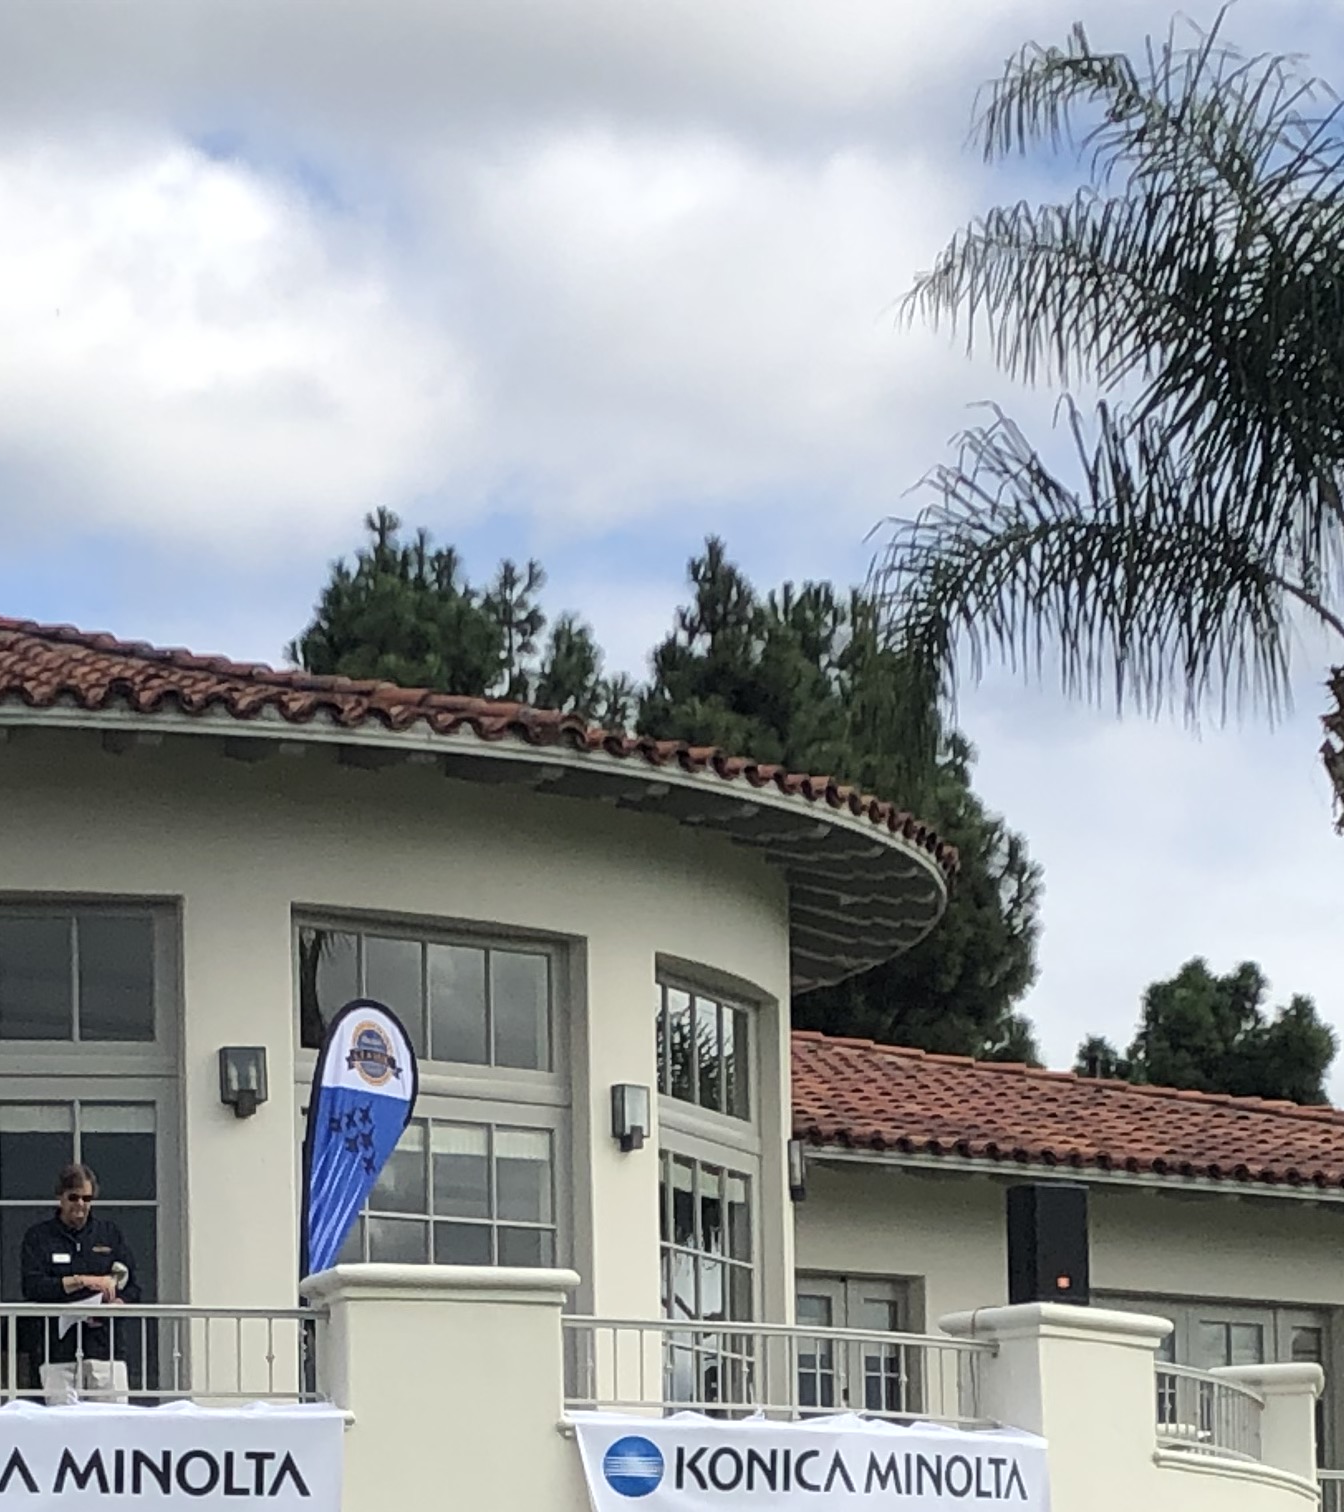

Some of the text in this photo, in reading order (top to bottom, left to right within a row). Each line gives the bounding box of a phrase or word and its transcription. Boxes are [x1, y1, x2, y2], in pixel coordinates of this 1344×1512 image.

[52, 1447, 311, 1497] MINOLTA
[675, 1446, 1028, 1500] KONICA MINOLTA
